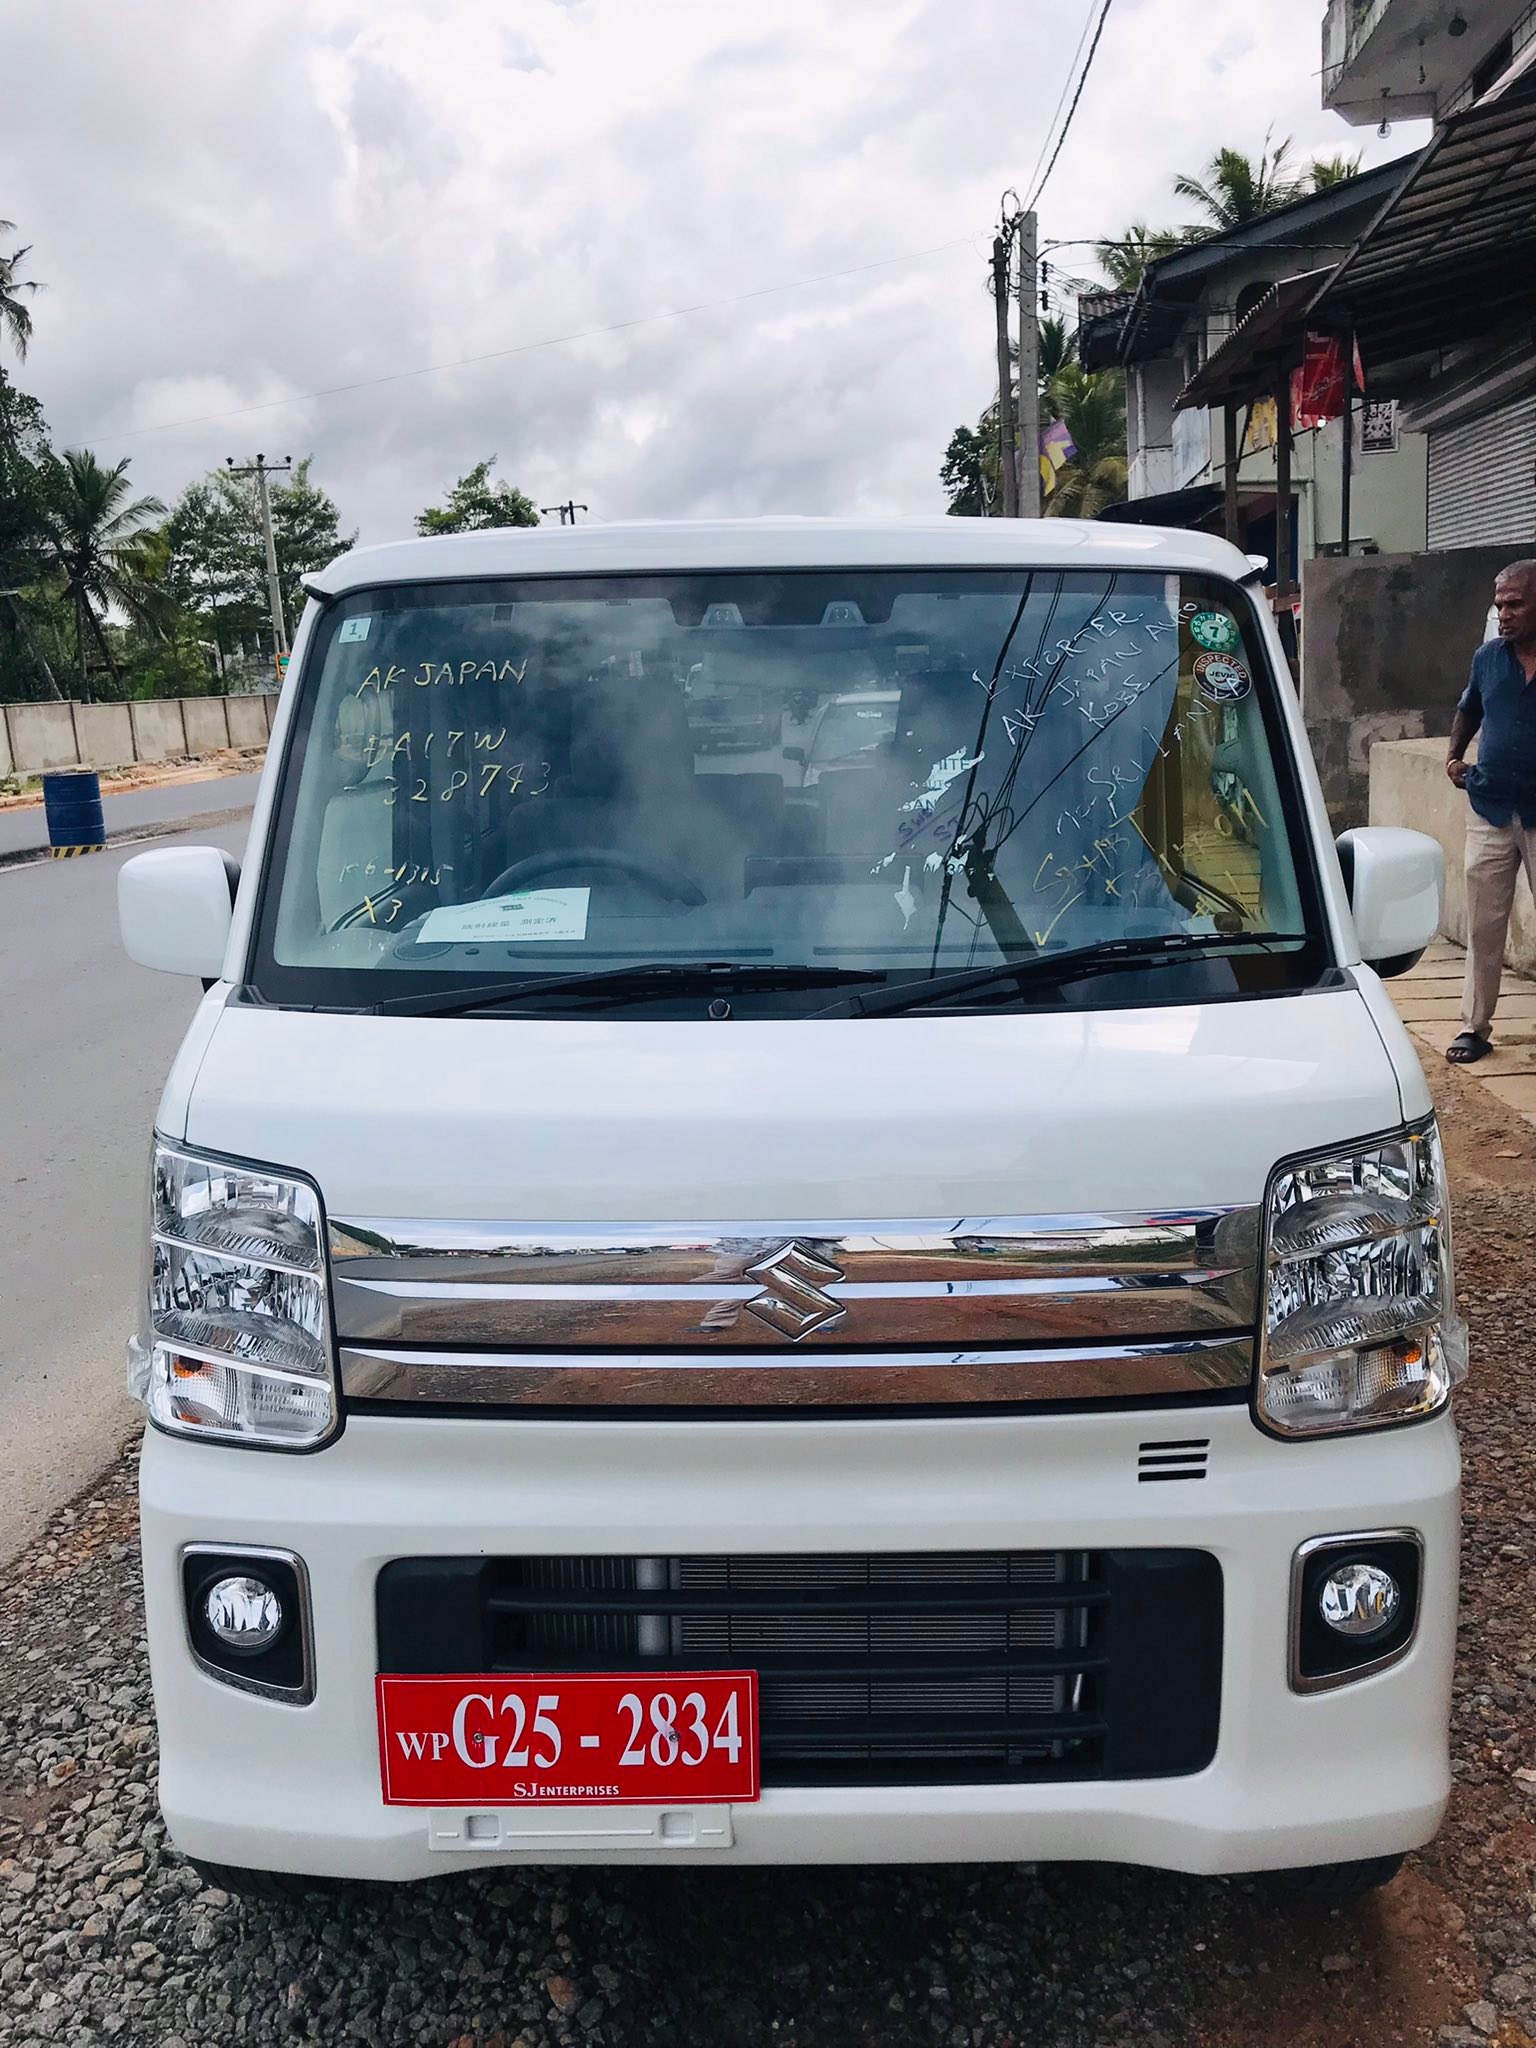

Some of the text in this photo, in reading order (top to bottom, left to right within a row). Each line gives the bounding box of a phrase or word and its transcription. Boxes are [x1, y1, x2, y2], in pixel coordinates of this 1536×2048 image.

[1209, 626, 1219, 639] 7
[356, 658, 527, 698] AK JAPAN
[1195, 654, 1248, 680] INSPECTED
[1209, 671, 1236, 679] JEVIC
[1002, 702, 1046, 746] AK
[396, 1732, 450, 1761] WP
[452, 1693, 562, 1769] G25
[617, 1691, 742, 1767] 2834
[540, 1785, 620, 1796] ENTERPRISES
